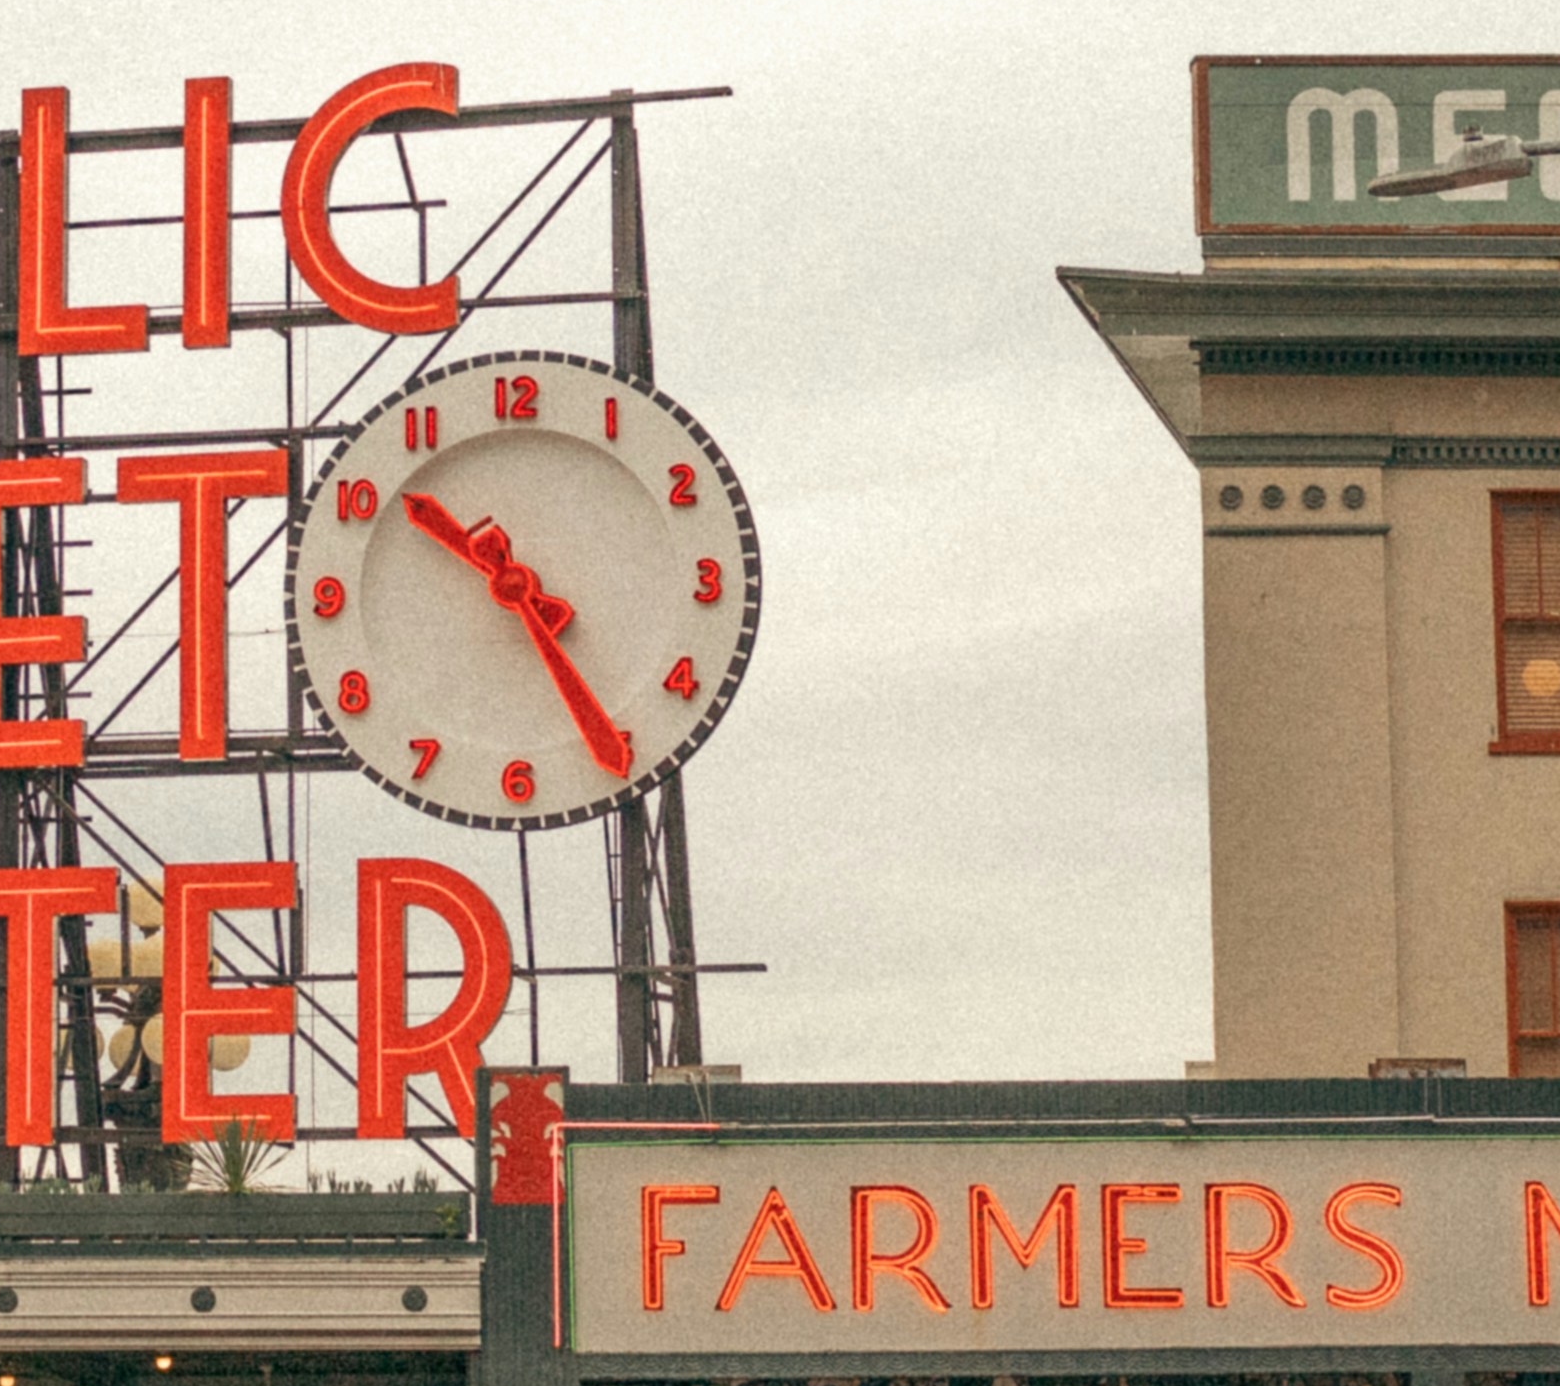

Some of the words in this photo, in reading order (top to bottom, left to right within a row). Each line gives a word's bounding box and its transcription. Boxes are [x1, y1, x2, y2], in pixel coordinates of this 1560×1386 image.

[494, 375, 539, 419] 12
[604, 397, 619, 440] 1
[404, 406, 438, 451] 11
[336, 479, 378, 521] 10
[668, 464, 697, 506] 2
[313, 577, 345, 618] 9
[693, 559, 722, 603] 3
[338, 670, 370, 714] 8
[662, 656, 700, 700] 4
[409, 738, 441, 780] 7
[501, 760, 535, 803] 6
[640, 1180, 1407, 1315] FARMERS
